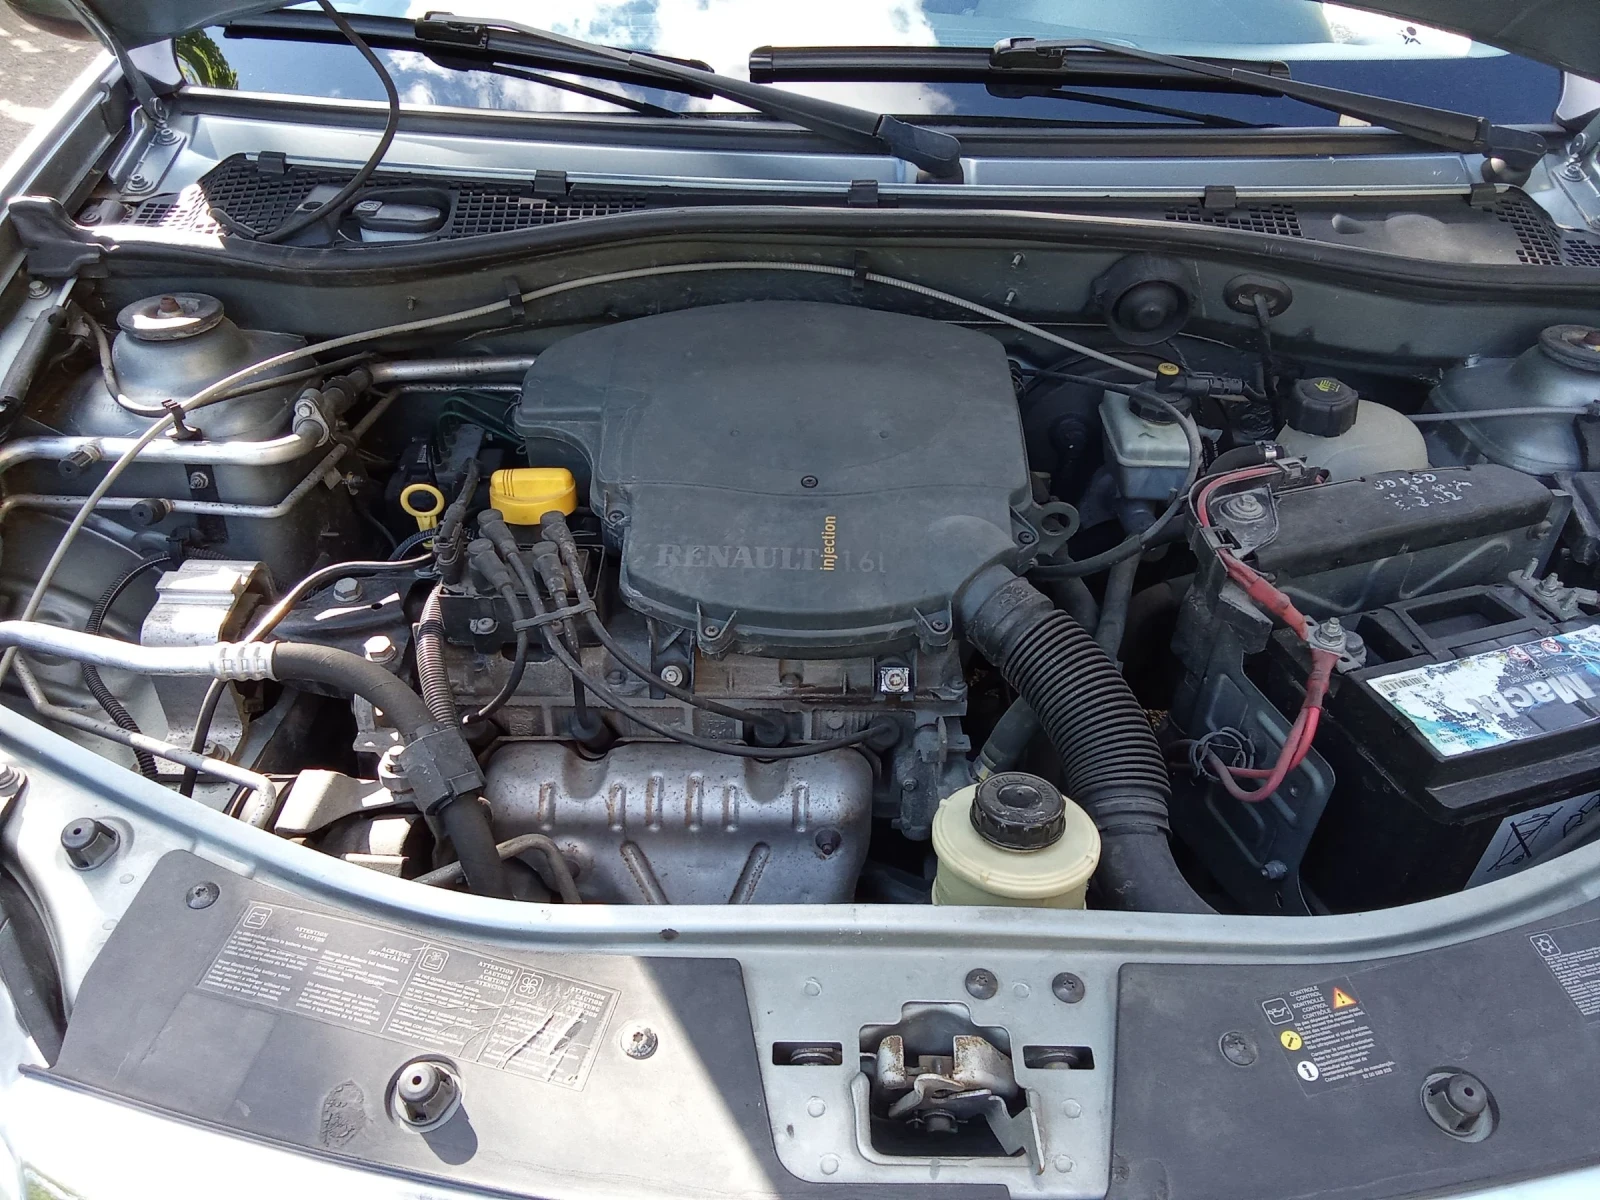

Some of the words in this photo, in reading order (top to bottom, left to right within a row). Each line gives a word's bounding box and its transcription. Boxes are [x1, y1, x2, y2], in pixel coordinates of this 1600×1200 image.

[820, 516, 838, 571] injection
[653, 543, 820, 571] RENAULT
[295, 925, 329, 939] ATTENTION
[298, 932, 326, 943] CAUTION
[381, 947, 412, 959] ACHTUNG
[477, 961, 515, 975] ATTENTION
[478, 974, 510, 987] ACHTUNG
[482, 969, 513, 981] CAUTION
[570, 987, 606, 1001] ATTENTION
[1290, 985, 1319, 996] CONTROLE
[1296, 991, 1322, 1001] CONTROL
[574, 995, 604, 1006] CAUTION
[1292, 996, 1325, 1008] KONTROLLE
[1302, 1003, 1328, 1013] CONTROL
